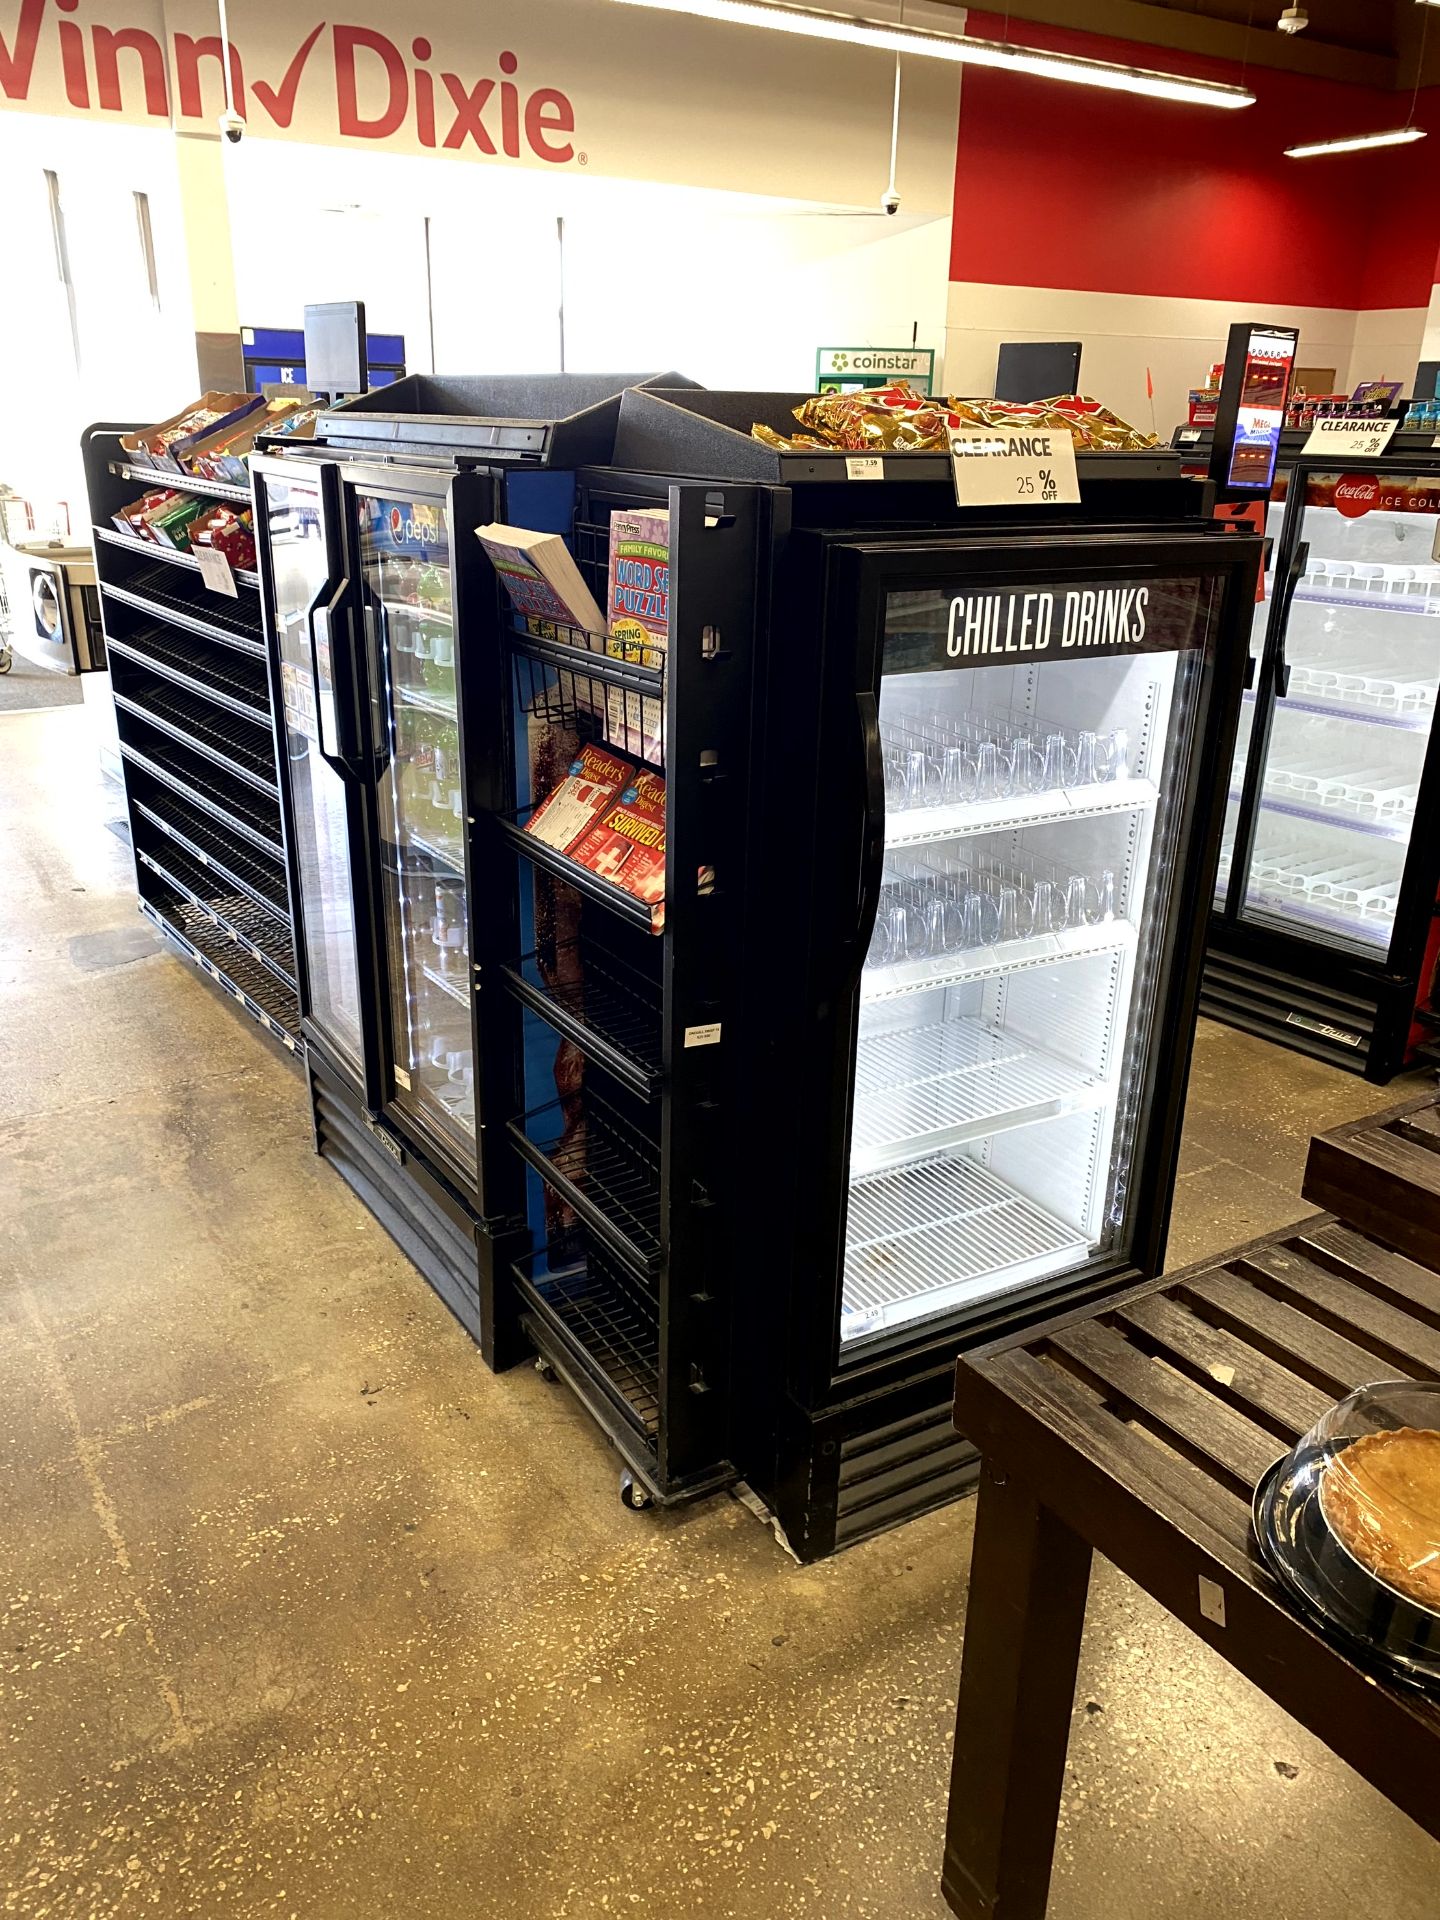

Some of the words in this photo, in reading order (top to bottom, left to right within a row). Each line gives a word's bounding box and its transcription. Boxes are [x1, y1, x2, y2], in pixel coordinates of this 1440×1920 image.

[853, 354, 917, 369] coinstar
[280, 367, 295, 384] ICE
[1321, 421, 1391, 432] CLEARANCE
[951, 437, 1053, 457] CLEARANCE
[1350, 440, 1364, 449] 25
[1369, 438, 1380, 448] %
[1016, 476, 1034, 493] 25
[1039, 469, 1056, 490] %
[1041, 490, 1058, 501] OFF
[1380, 496, 1402, 506] ICE
[405, 519, 439, 548] pepsi
[620, 544, 643, 554] FAMILY
[615, 557, 652, 591] WORD
[946, 592, 1054, 657] CHILLED
[1061, 586, 1149, 648] DRINKS
[614, 628, 641, 640] SPRING
[580, 748, 625, 782] Reader's
[580, 767, 601, 783] Digest
[634, 795, 657, 813] Digest
[608, 813, 661, 846] SURVIVED
